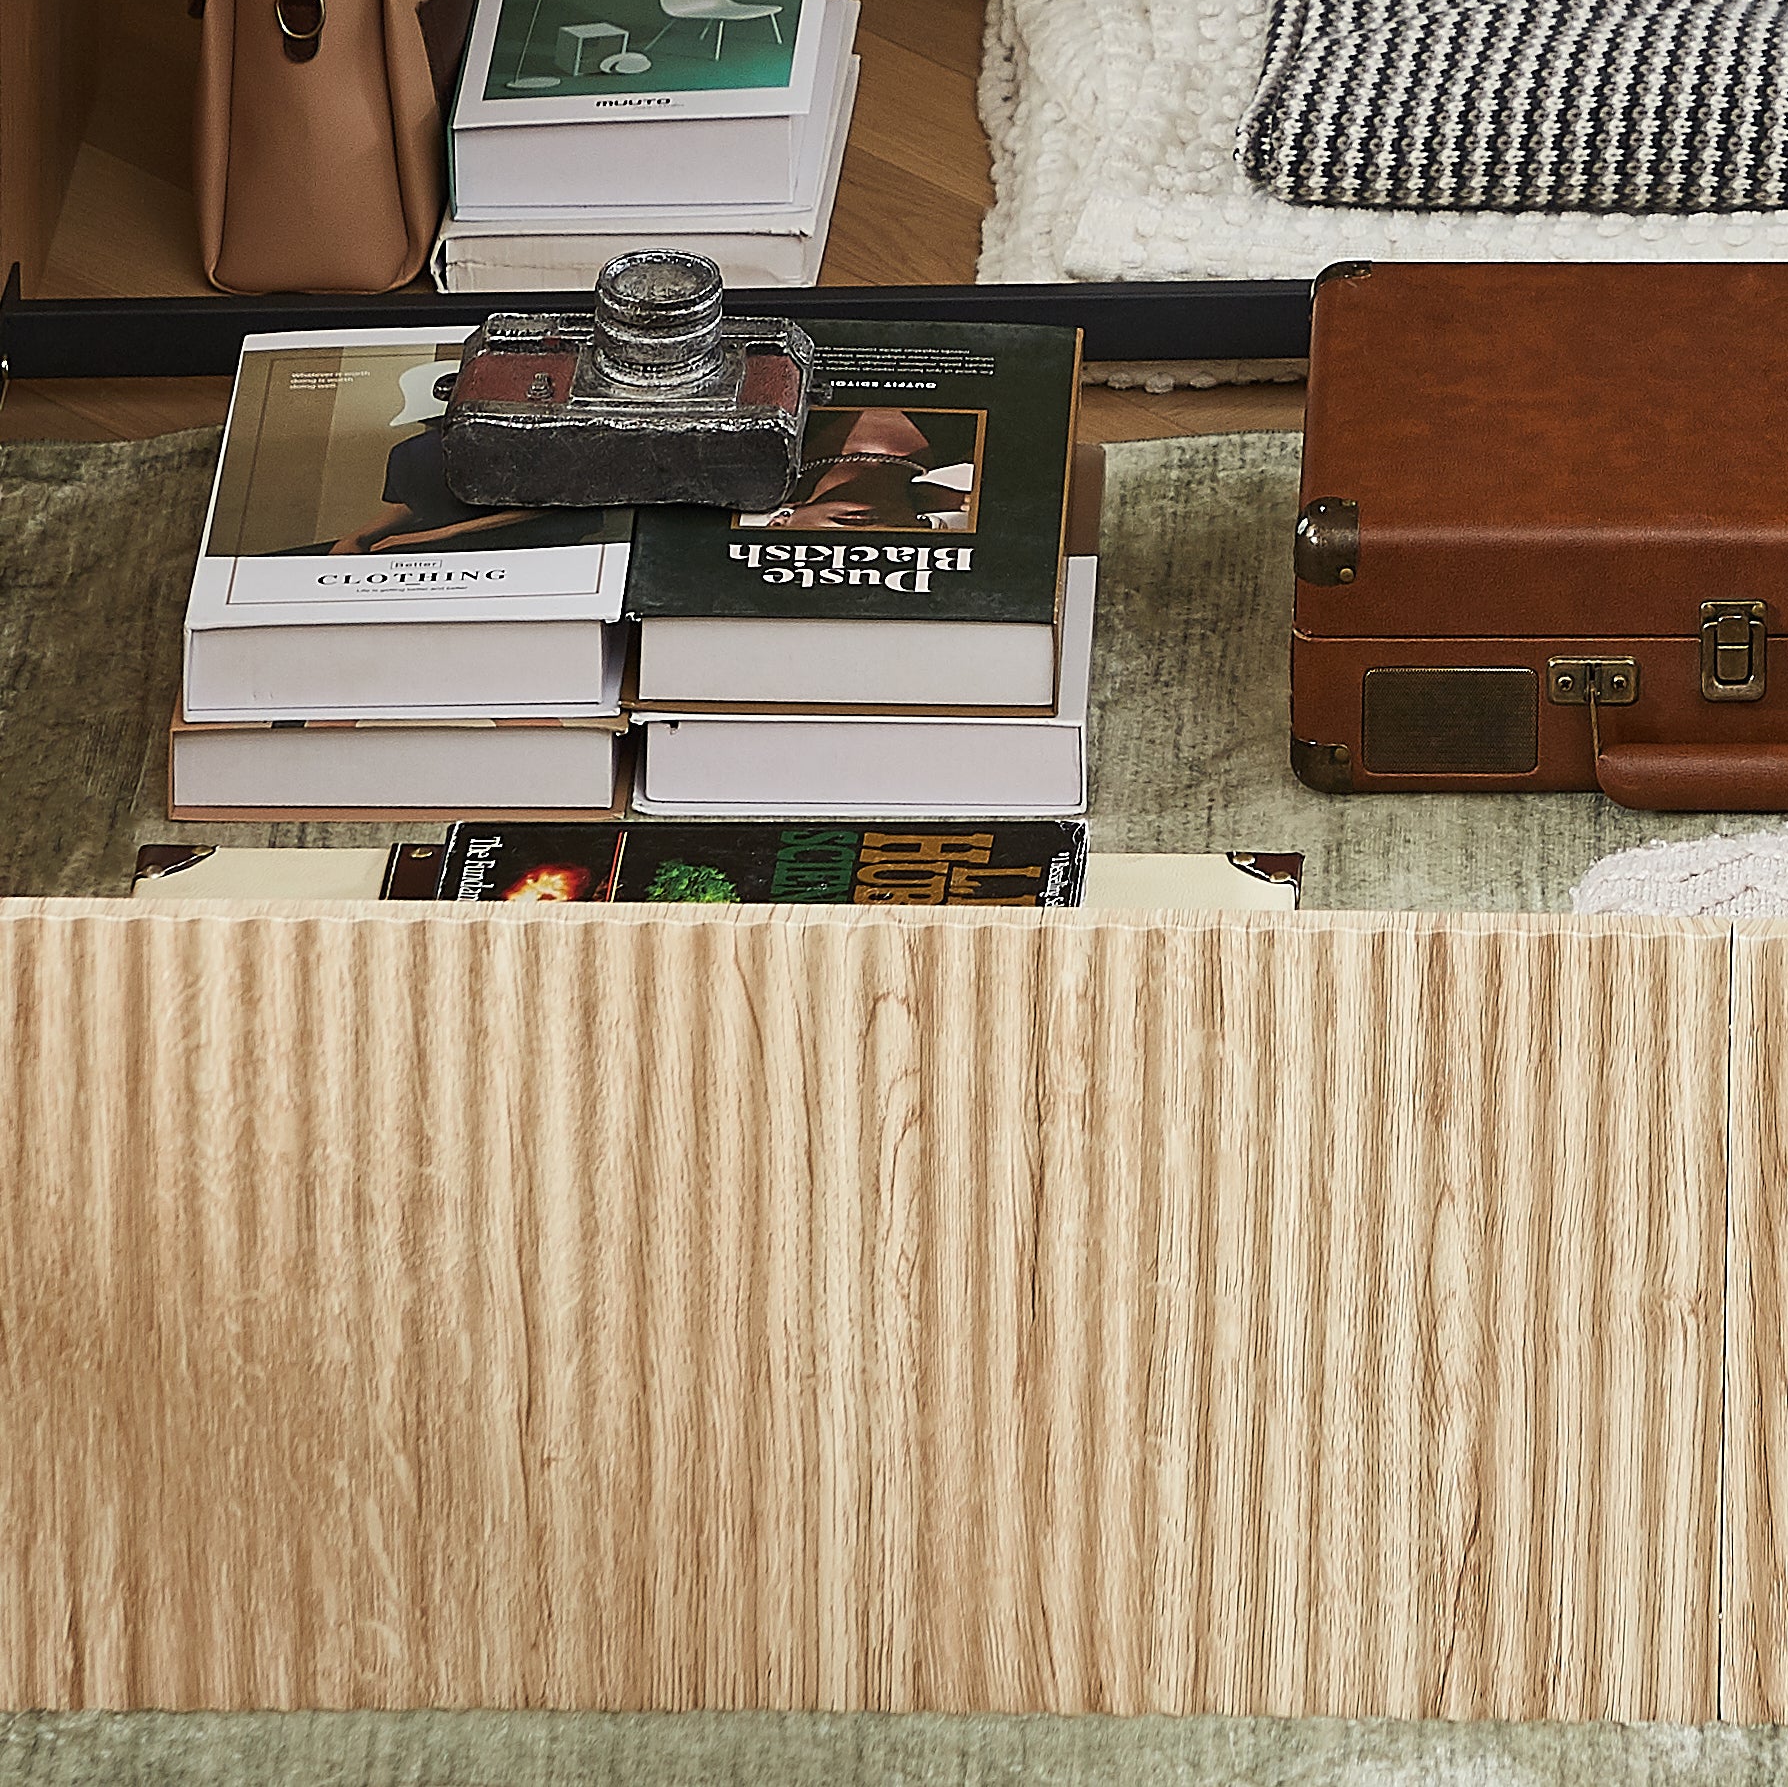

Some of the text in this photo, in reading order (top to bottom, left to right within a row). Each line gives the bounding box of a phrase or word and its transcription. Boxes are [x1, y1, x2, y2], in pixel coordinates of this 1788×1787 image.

[595, 97, 672, 107] muuto
[883, 380, 937, 389] OUTFIT
[395, 561, 437, 569] Better
[727, 543, 974, 571] Blackish
[317, 569, 506, 586] CLOTHING
[761, 566, 934, 594] Duste
[466, 836, 503, 859] The
